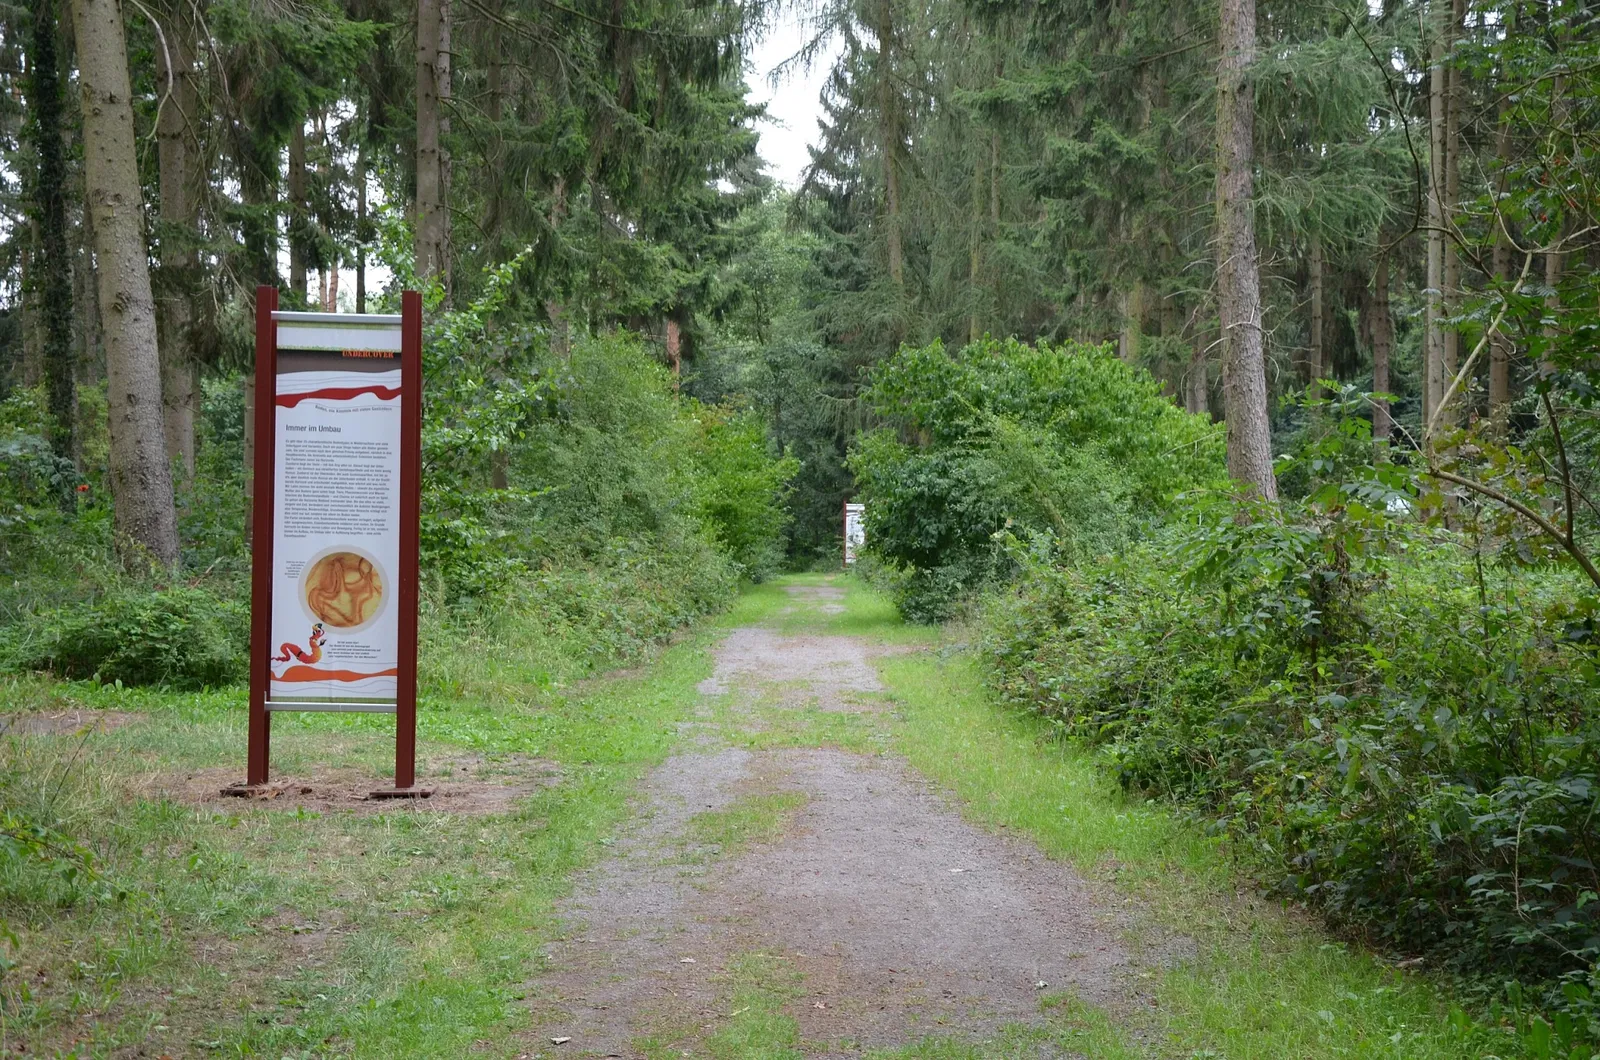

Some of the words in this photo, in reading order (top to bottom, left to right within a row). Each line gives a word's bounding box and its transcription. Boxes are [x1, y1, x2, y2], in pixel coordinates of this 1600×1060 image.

[342, 350, 394, 358] UNDERCOVER
[285, 424, 307, 432] Immer
[308, 424, 317, 432] im
[318, 425, 342, 433] Umbau
